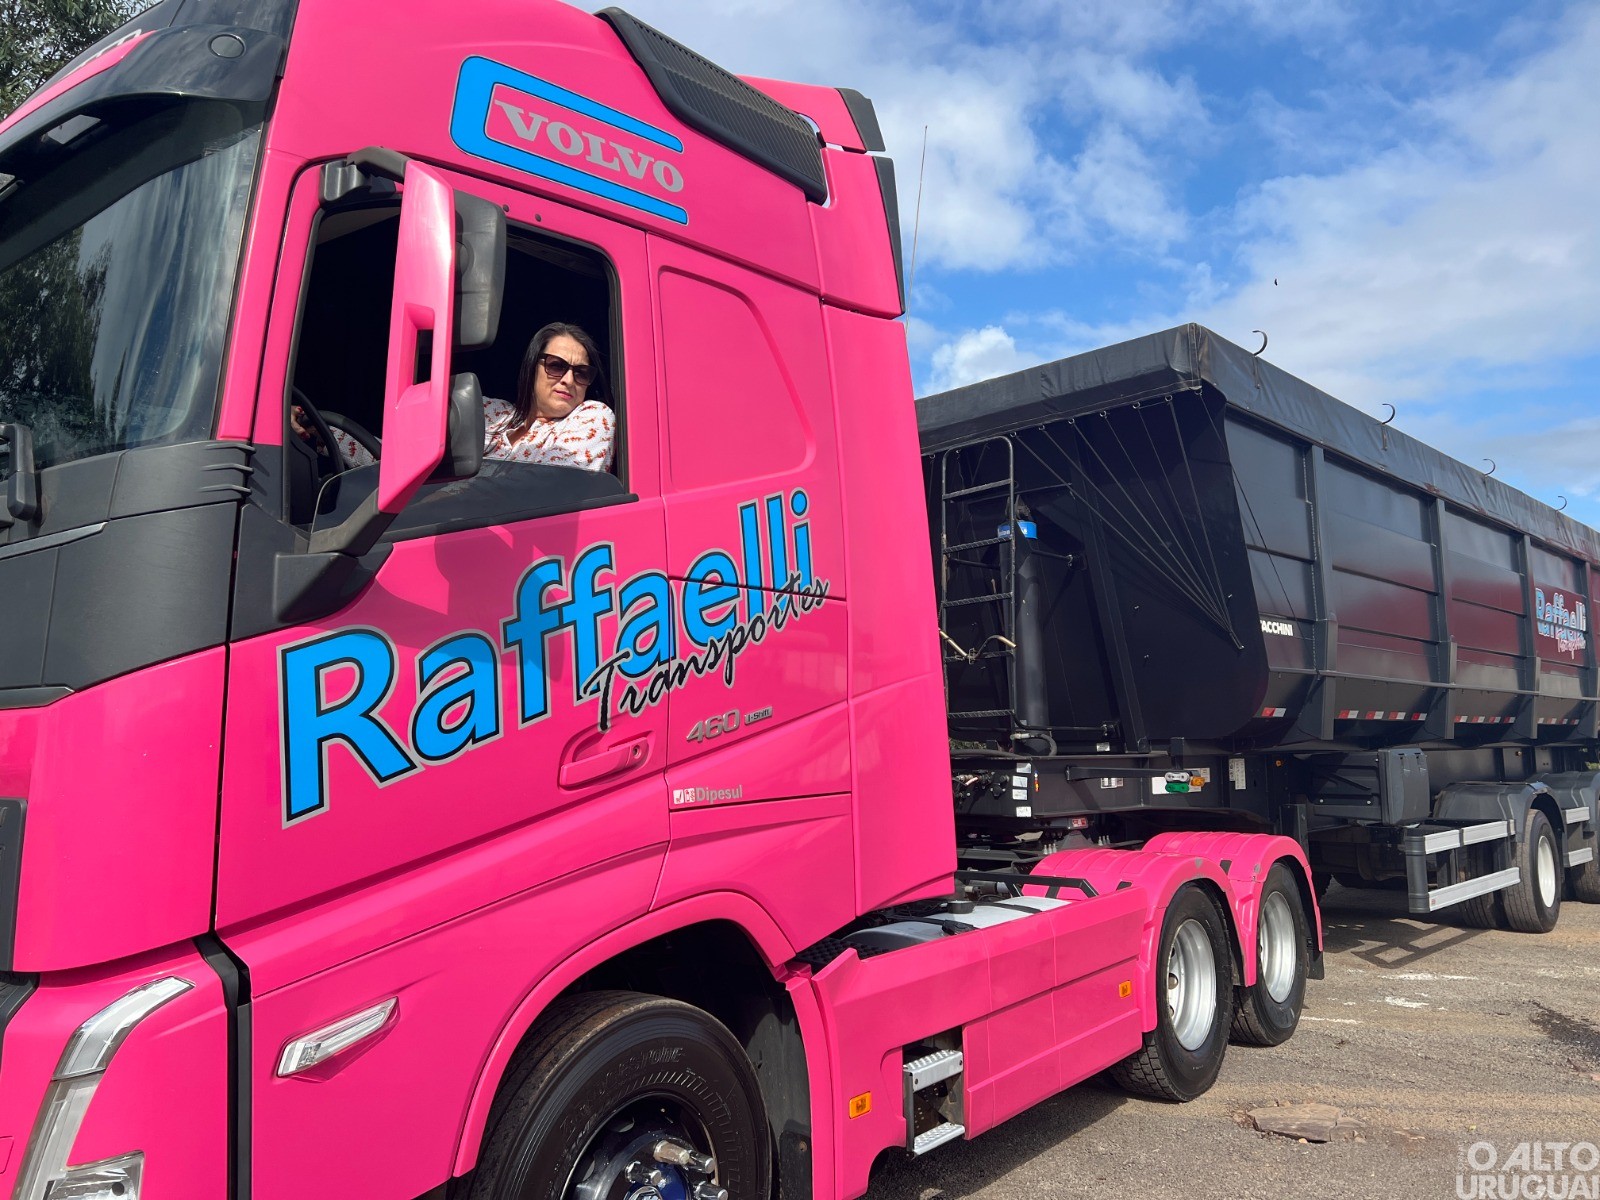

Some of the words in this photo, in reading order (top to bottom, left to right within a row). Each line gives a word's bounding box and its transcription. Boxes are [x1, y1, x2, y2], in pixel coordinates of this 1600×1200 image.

[494, 99, 684, 192] VOLVO
[277, 487, 810, 828] Raffaelli
[580, 570, 830, 734] Transportes
[1260, 619, 1294, 637] ACCHINI
[686, 708, 740, 743] 460
[745, 706, 772, 725] I-Shift
[695, 784, 743, 805] Dipesul
